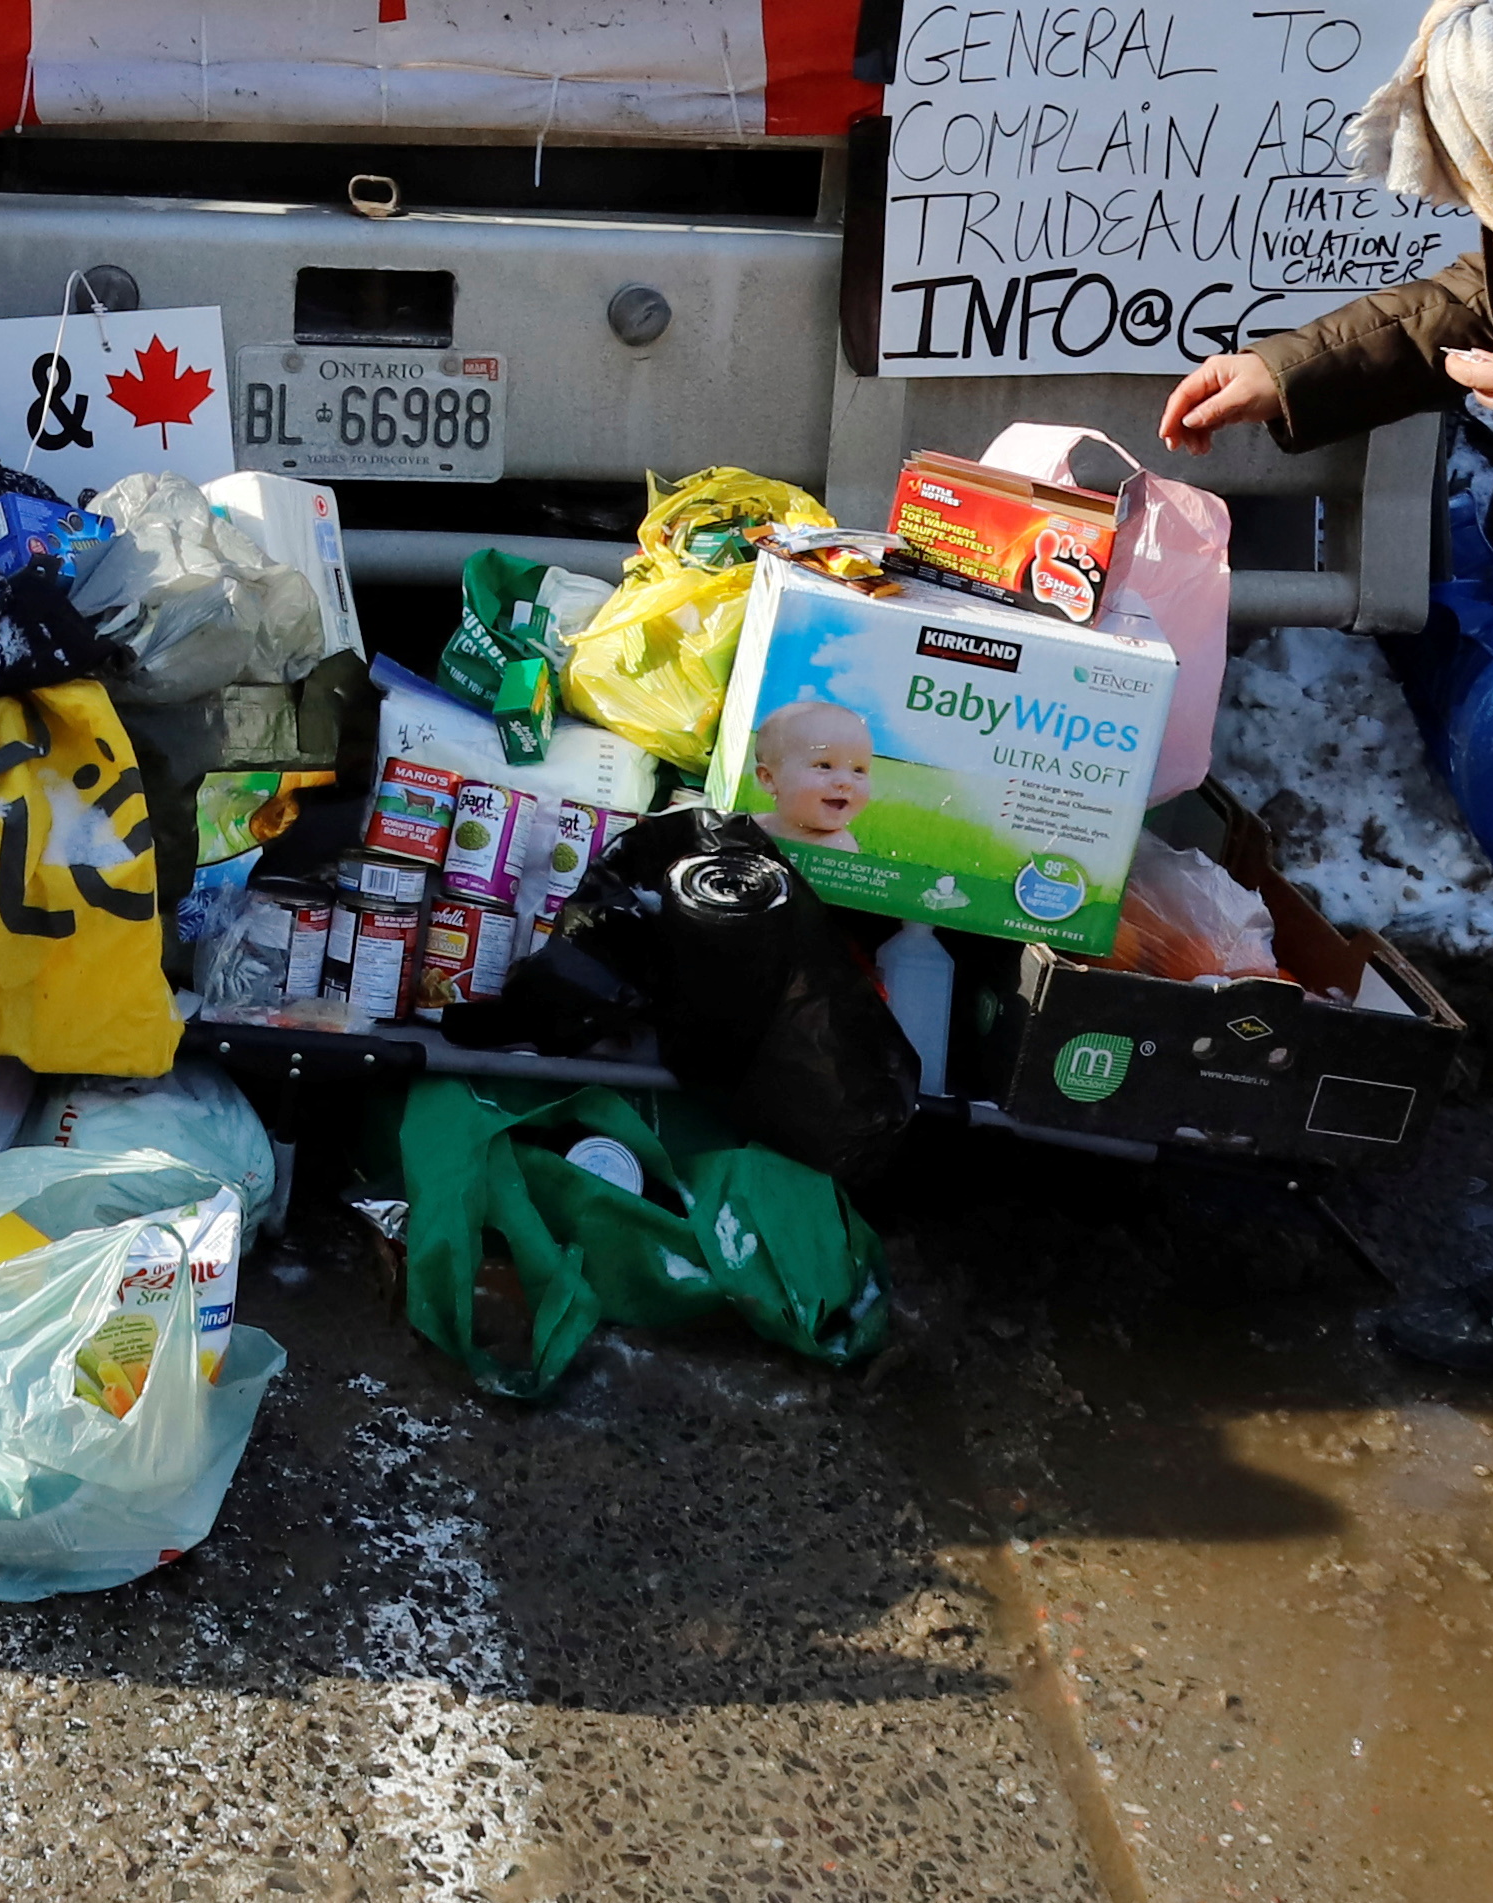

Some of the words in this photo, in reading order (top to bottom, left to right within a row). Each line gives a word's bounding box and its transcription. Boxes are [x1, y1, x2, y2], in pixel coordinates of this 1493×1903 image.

[904, 6, 1218, 85] GENERAL
[1253, 11, 1361, 73] TO
[892, 190, 1242, 265] TRUDEAU
[1285, 187, 1379, 221] HATE
[1283, 260, 1425, 285] CHARTER
[319, 360, 424, 381] ONTARIO
[464, 362, 487, 374] MAR
[27, 352, 94, 451] &
[246, 383, 303, 446] BL
[339, 385, 492, 451] 66988
[306, 454, 346, 465] YOURS
[351, 455, 365, 465] TO
[371, 454, 430, 466] DISCOVER
[920, 489, 959, 507] HOTTIES
[922, 482, 953, 496] LITTLE
[901, 510, 924, 523] TOE
[924, 516, 977, 540] WARMERS
[897, 520, 994, 556] CHAUFFE-ORTEILS
[922, 552, 959, 571] DEDOS
[959, 563, 980, 578] DEL
[981, 570, 1000, 583] PIE
[924, 630, 1017, 661] KIRKLAND
[1091, 671, 1151, 694] TENCEL
[395, 767, 449, 787] MARIO'S
[993, 745, 1061, 776] ULTRA
[1070, 761, 1130, 788] SOFT
[1072, 801, 1113, 815] Chamomile
[381, 819, 414, 832] CORNED
[416, 825, 437, 835] BEEF
[1004, 919, 1058, 937] FRAGRANCE
[1062, 931, 1085, 942] FREE
